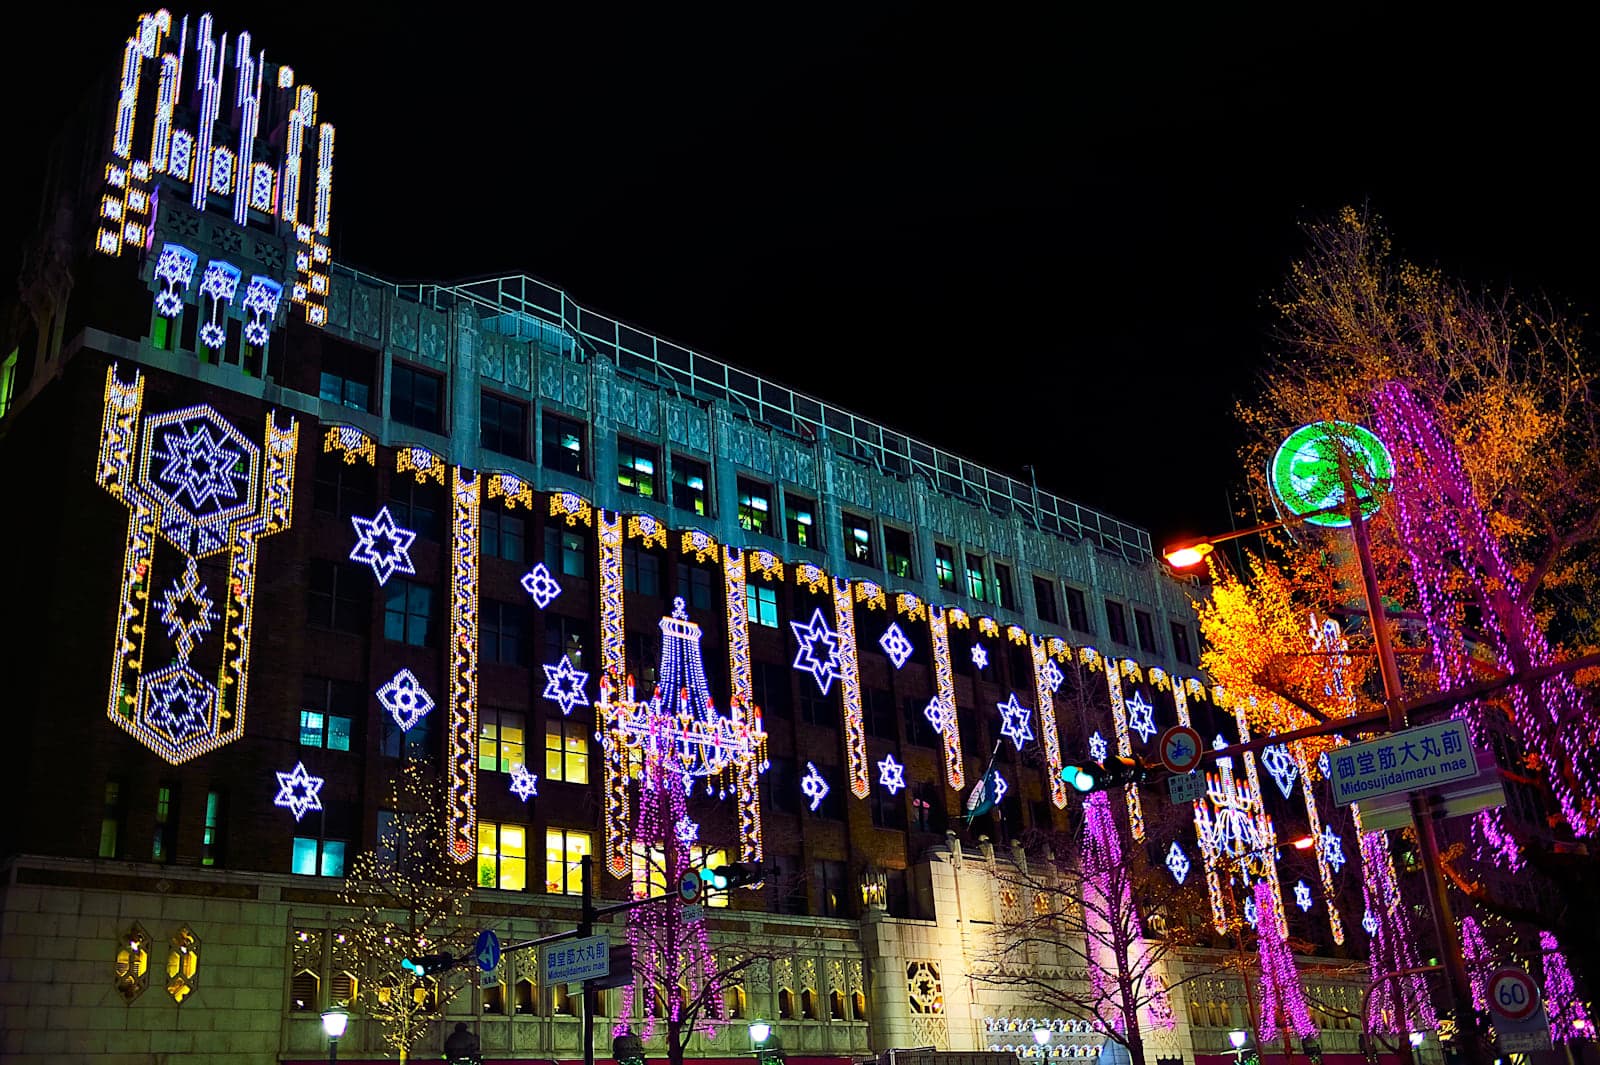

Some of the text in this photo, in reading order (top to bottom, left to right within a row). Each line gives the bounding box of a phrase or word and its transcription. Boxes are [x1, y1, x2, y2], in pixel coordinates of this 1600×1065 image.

[1336, 729, 1463, 780] 御堂筋大丸前
[1340, 757, 1467, 796] Midosujidaimaru mae
[1499, 983, 1526, 1006] 60
